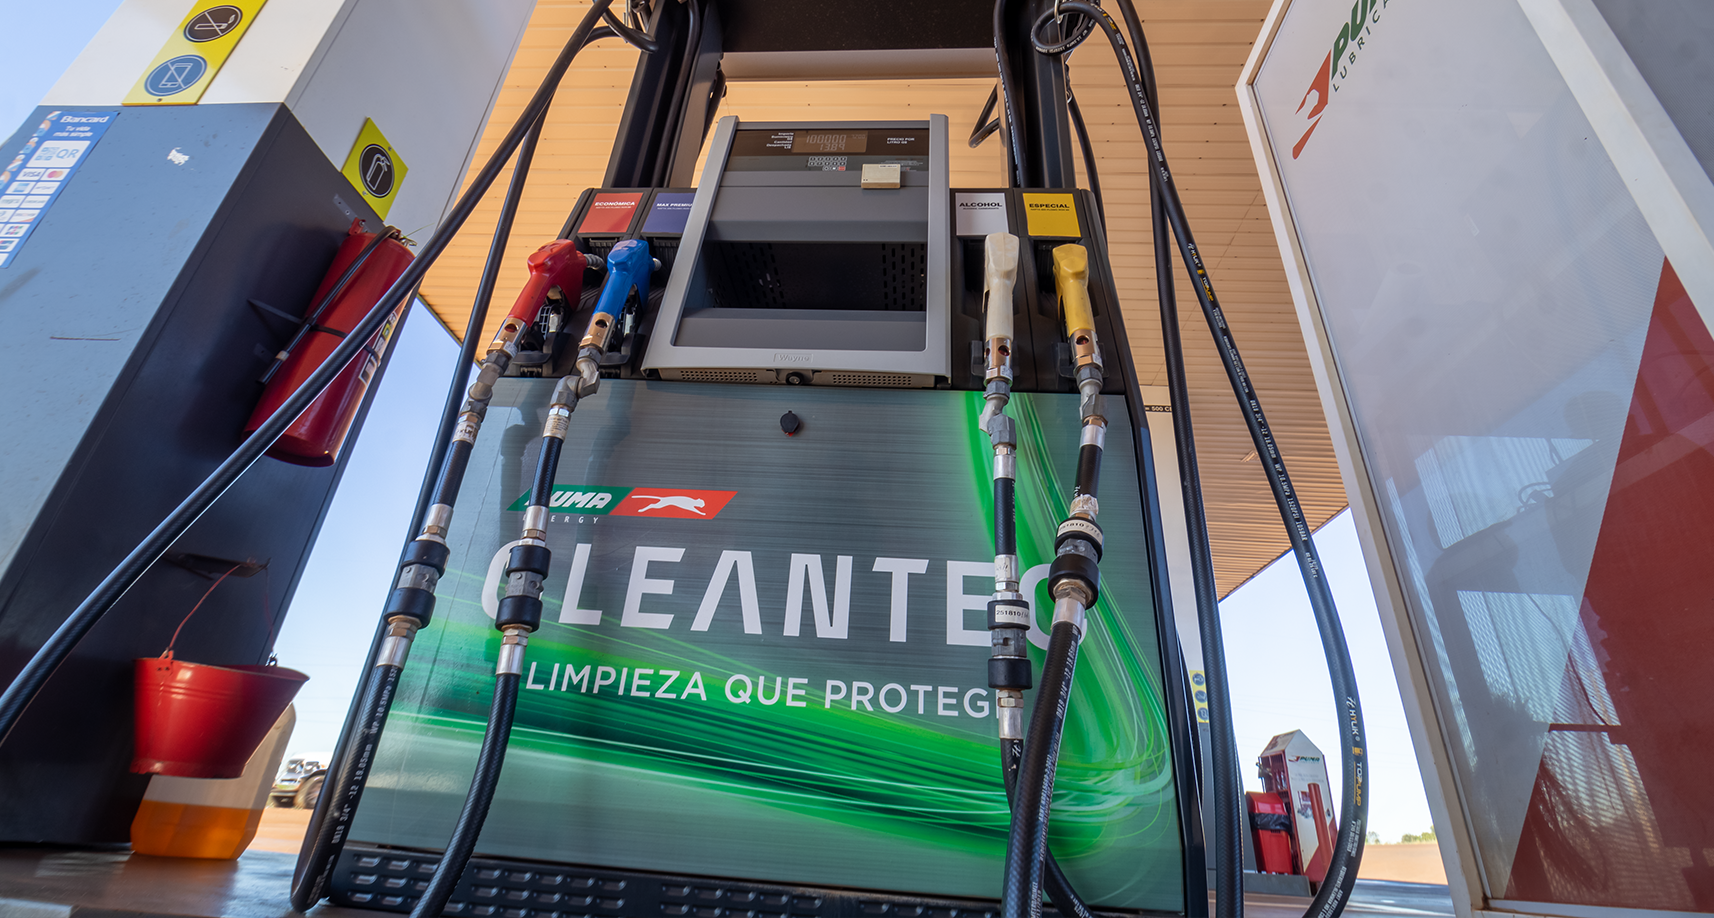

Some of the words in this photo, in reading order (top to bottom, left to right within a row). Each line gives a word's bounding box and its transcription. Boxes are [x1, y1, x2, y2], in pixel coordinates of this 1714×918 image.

[1331, 0, 1376, 80] PU
[60, 115, 110, 123] Bancard
[56, 149, 79, 159] QR
[779, 354, 810, 362] Wayne
[524, 491, 612, 508] UMA
[526, 661, 707, 701] LIMPIEZA
[724, 673, 808, 708] QUE
[824, 678, 999, 719] PROTEG
